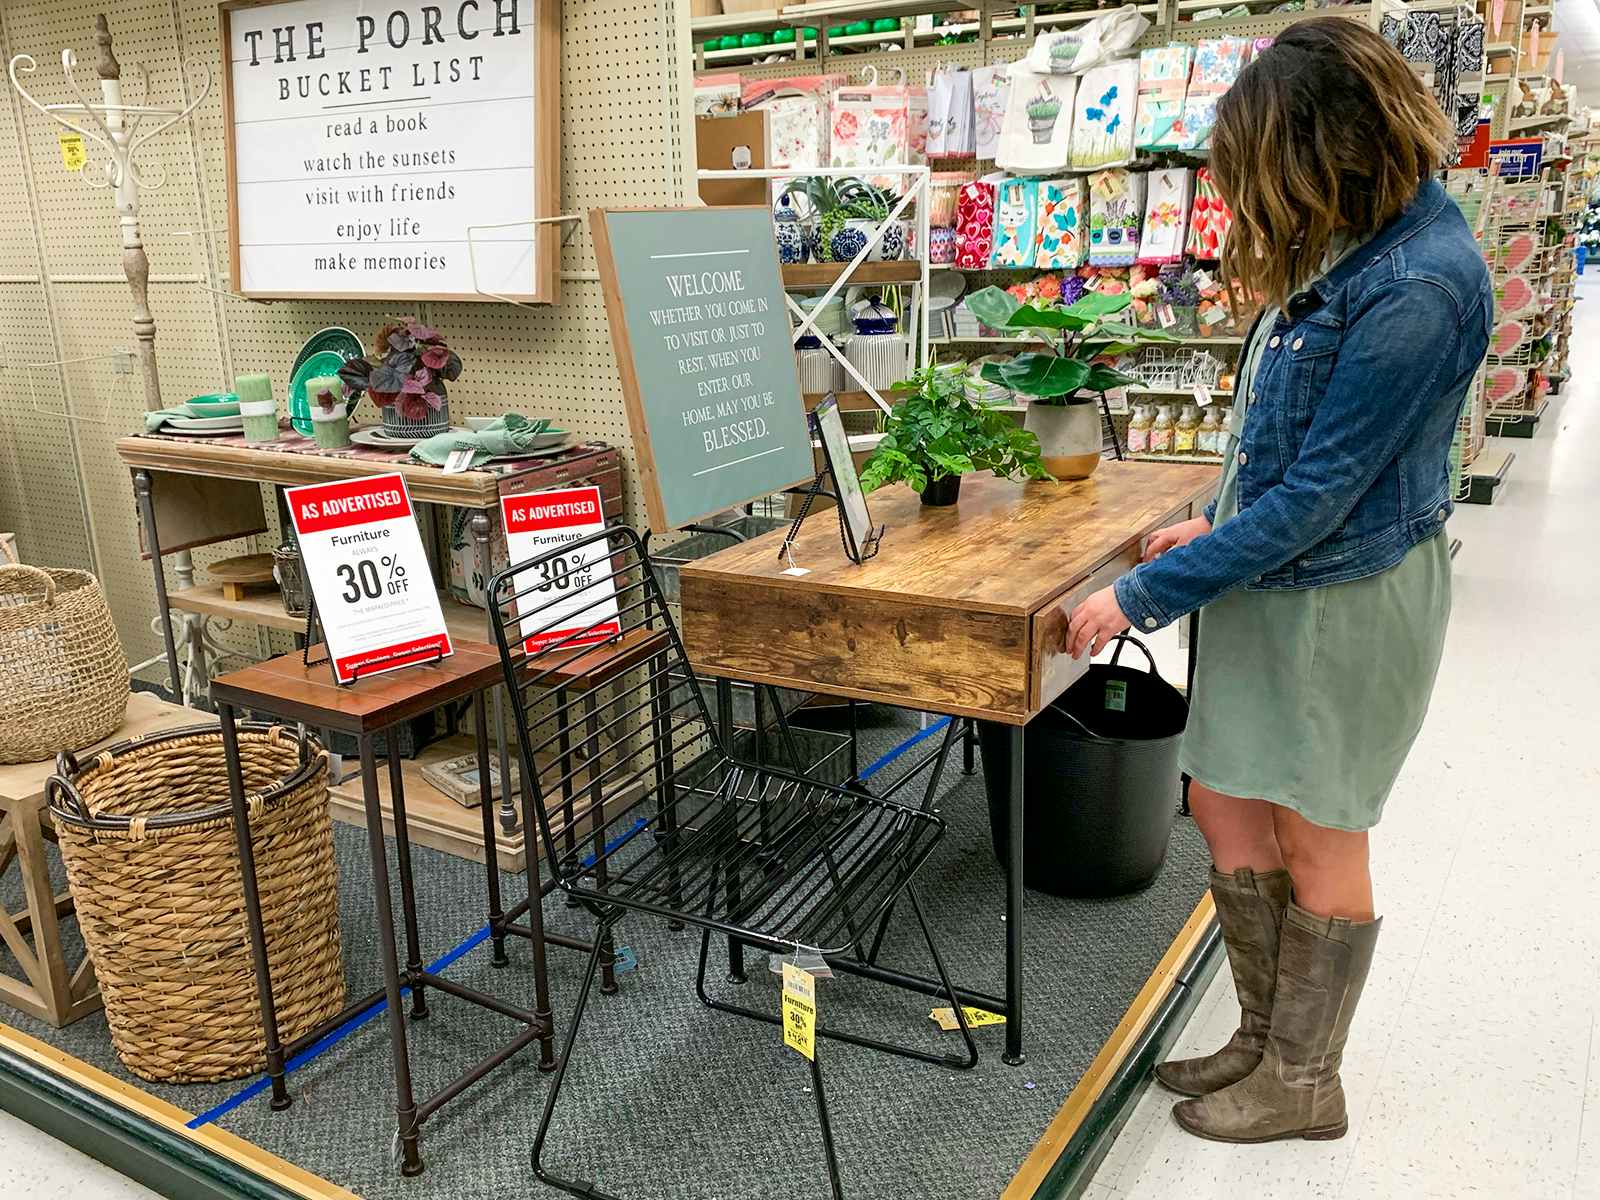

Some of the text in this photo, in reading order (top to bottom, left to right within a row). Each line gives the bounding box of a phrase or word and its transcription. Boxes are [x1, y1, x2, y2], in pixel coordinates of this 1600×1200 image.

[244, 0, 521, 66] THE PORCH
[278, 56, 483, 100] BUCKET LIST
[326, 112, 428, 138] read a book
[304, 148, 456, 172] watch the sunsets
[305, 181, 456, 205] visit with friends
[336, 217, 421, 241] enjoy life
[314, 252, 446, 270] make memories
[666, 270, 745, 297] WELCOME
[649, 297, 769, 327] WHETHER YOU COME IN
[664, 321, 765, 351] TO VISIT OR JUST TO
[708, 350, 738, 369] WHEN
[740, 346, 761, 362] YOU
[698, 372, 754, 397] ENTER OUR
[716, 400, 739, 418] MAY
[739, 394, 761, 412] YOU
[762, 391, 775, 407] BE
[702, 417, 770, 453] BLESSED.
[301, 490, 402, 520] AS ADVERTISED
[512, 500, 595, 522] AS ADVERTISED
[331, 528, 390, 547] Furniture
[533, 533, 582, 546] Furniture
[337, 553, 406, 604] 30%
[534, 553, 591, 592] 30%
[574, 575, 592, 588] OFF
[387, 578, 409, 595] OFF
